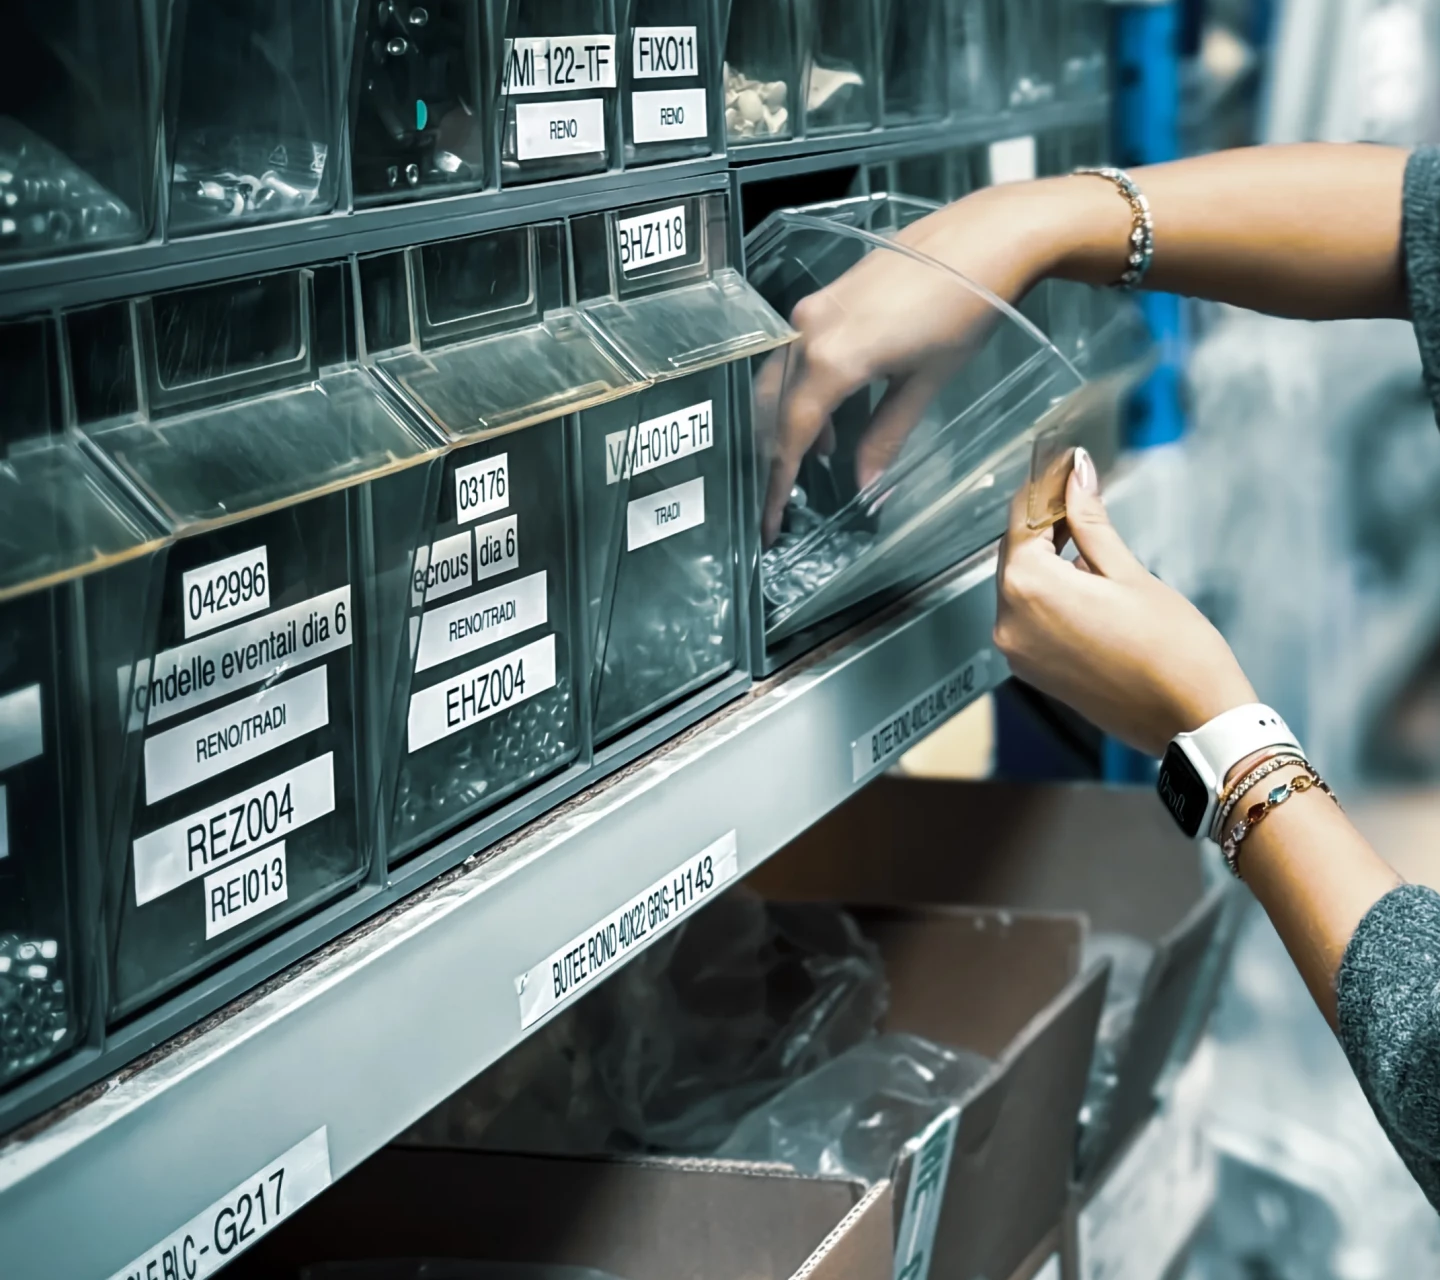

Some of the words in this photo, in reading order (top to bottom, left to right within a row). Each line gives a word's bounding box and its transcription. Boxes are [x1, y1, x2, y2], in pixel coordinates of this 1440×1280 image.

[550, 119, 578, 140] RENO
[660, 106, 684, 126] RENO
[620, 215, 683, 264] BHZ118
[458, 467, 506, 511] 03176
[654, 500, 681, 526] TRADI
[480, 535, 502, 567] dia
[507, 528, 515, 558] 6
[189, 561, 266, 621] 042996
[448, 599, 516, 643] RENO/TRADI
[134, 655, 215, 713] ondelle
[221, 619, 297, 680] eventail
[302, 611, 330, 648] dia
[335, 601, 347, 636] 6
[446, 658, 526, 728] EHZ004
[196, 703, 287, 764] RENO/TRADI
[187, 782, 295, 872] REZ004
[210, 857, 284, 923] REI013
[552, 942, 588, 999] BUTEE
[588, 922, 618, 974] ROND
[618, 900, 647, 950] 40X22
[213, 1166, 286, 1257] G217
